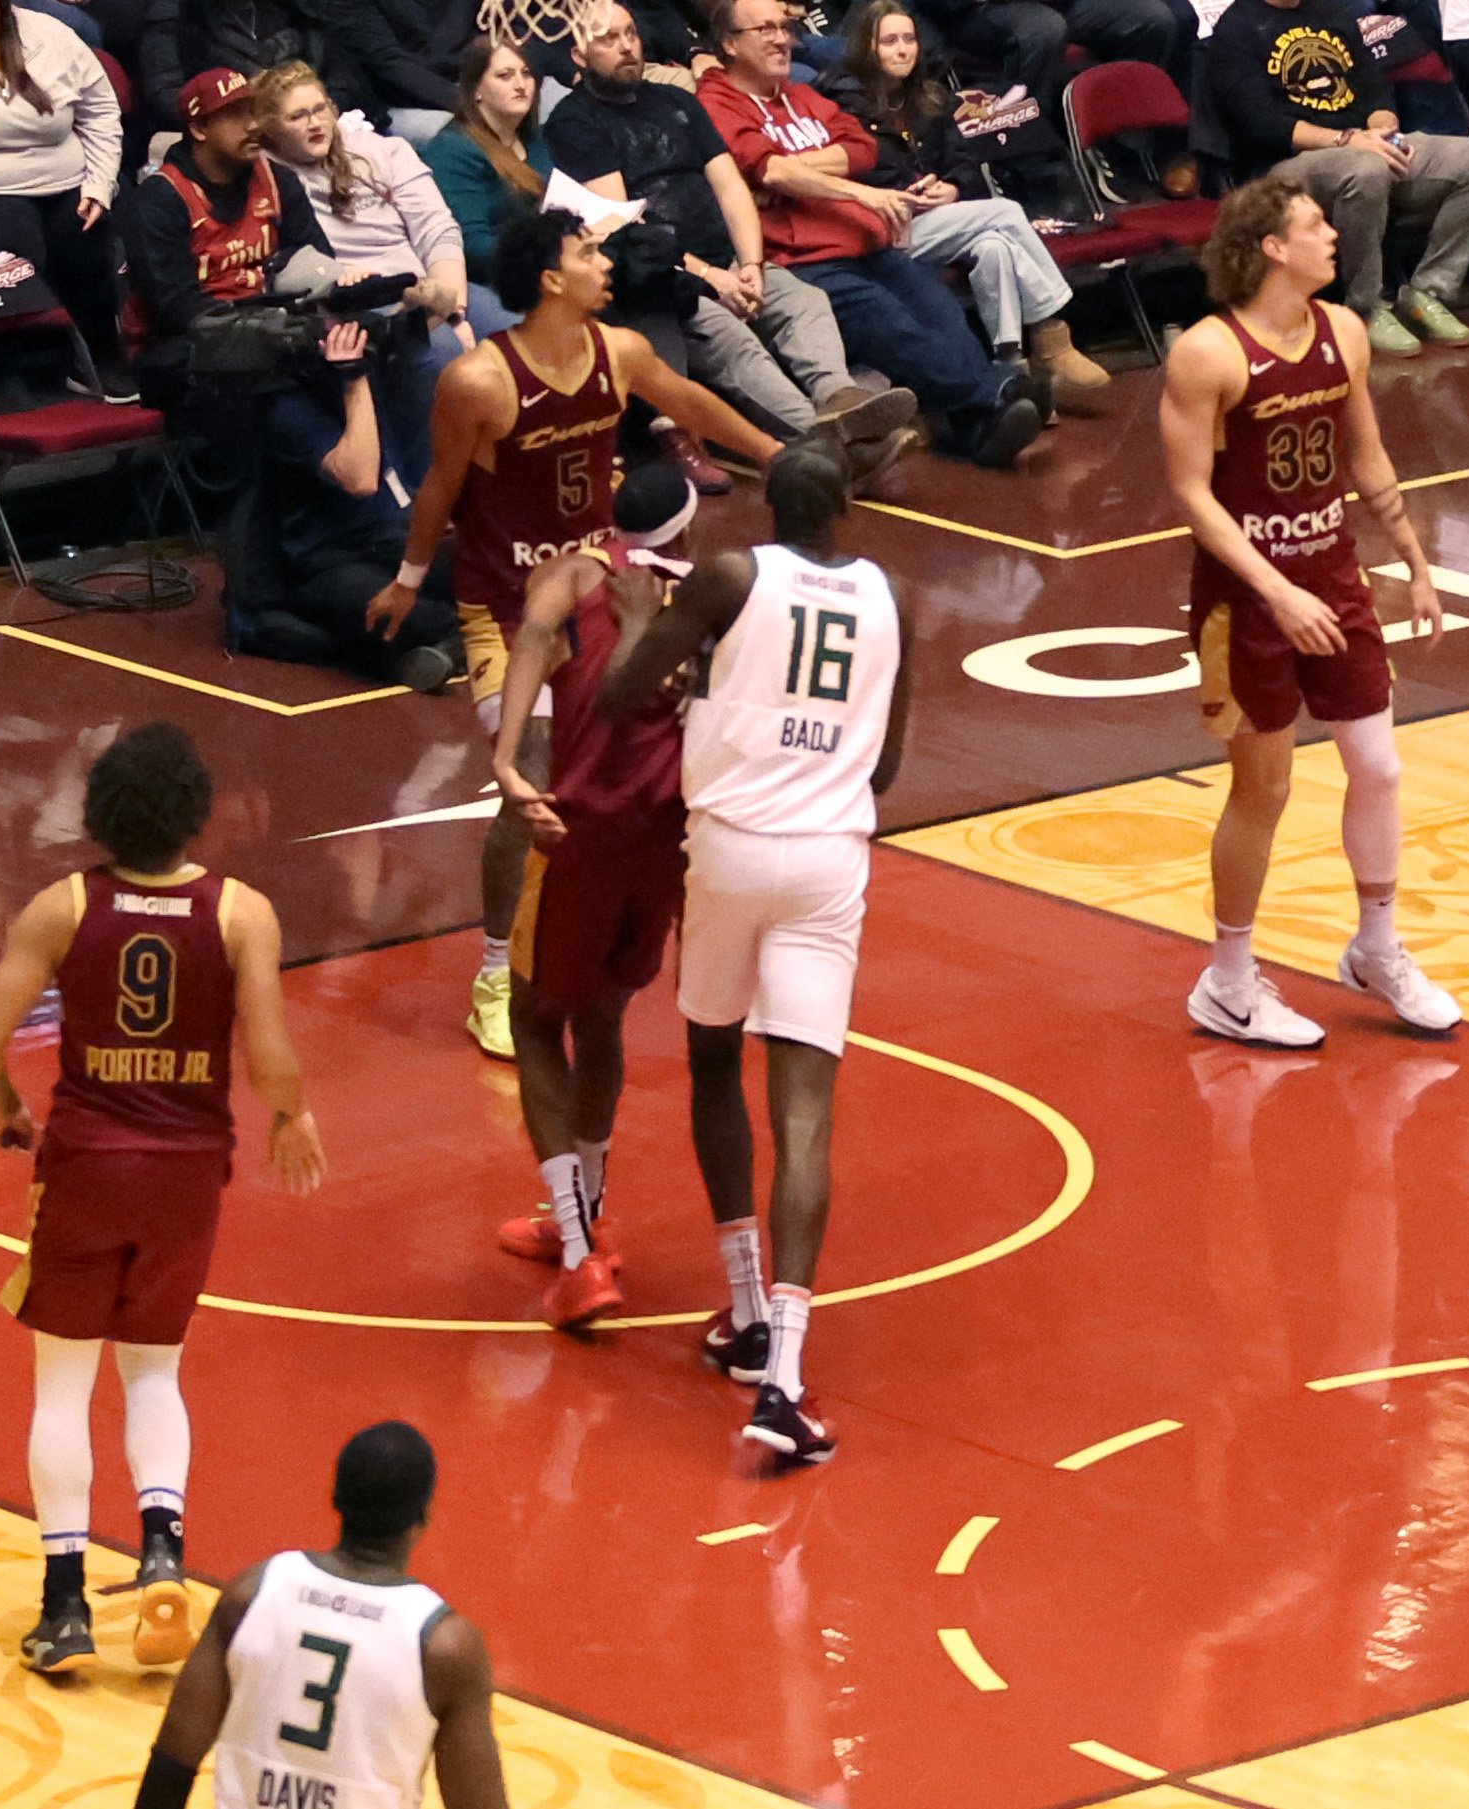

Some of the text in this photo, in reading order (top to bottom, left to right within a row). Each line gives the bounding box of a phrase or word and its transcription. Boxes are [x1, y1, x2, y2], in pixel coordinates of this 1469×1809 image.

[1267, 27, 1354, 75] CLEVELAND
[1371, 44, 1389, 60] 12
[997, 132, 1007, 145] 9
[1266, 416, 1336, 492] 33
[557, 450, 592, 516] 5
[1242, 497, 1344, 541] ROCKE
[785, 604, 856, 702] 16
[116, 933, 177, 1038] 9
[85, 1045, 177, 1083] PORTER
[277, 1630, 349, 1752] 3
